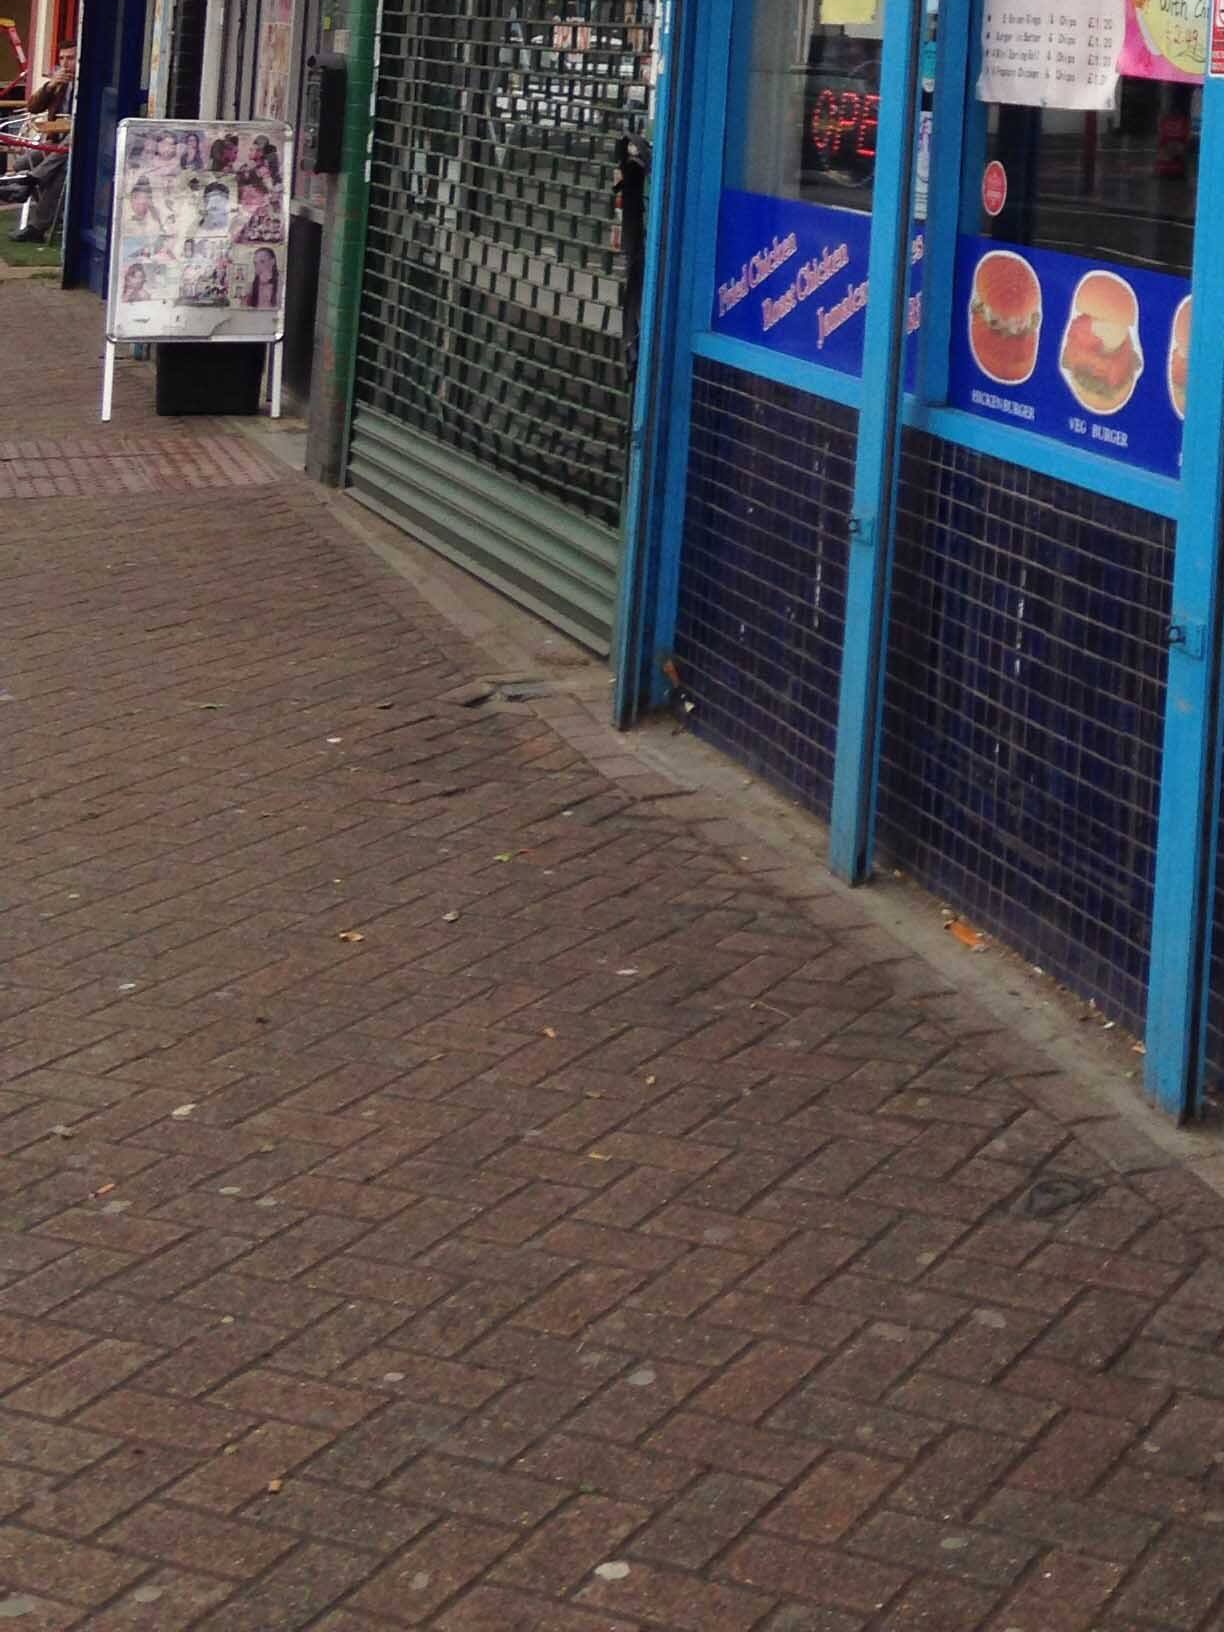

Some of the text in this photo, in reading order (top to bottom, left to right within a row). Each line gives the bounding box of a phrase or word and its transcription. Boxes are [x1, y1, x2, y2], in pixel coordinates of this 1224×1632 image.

[812, 87, 883, 156] OPE
[1068, 417, 1129, 448] VEG BURGER
